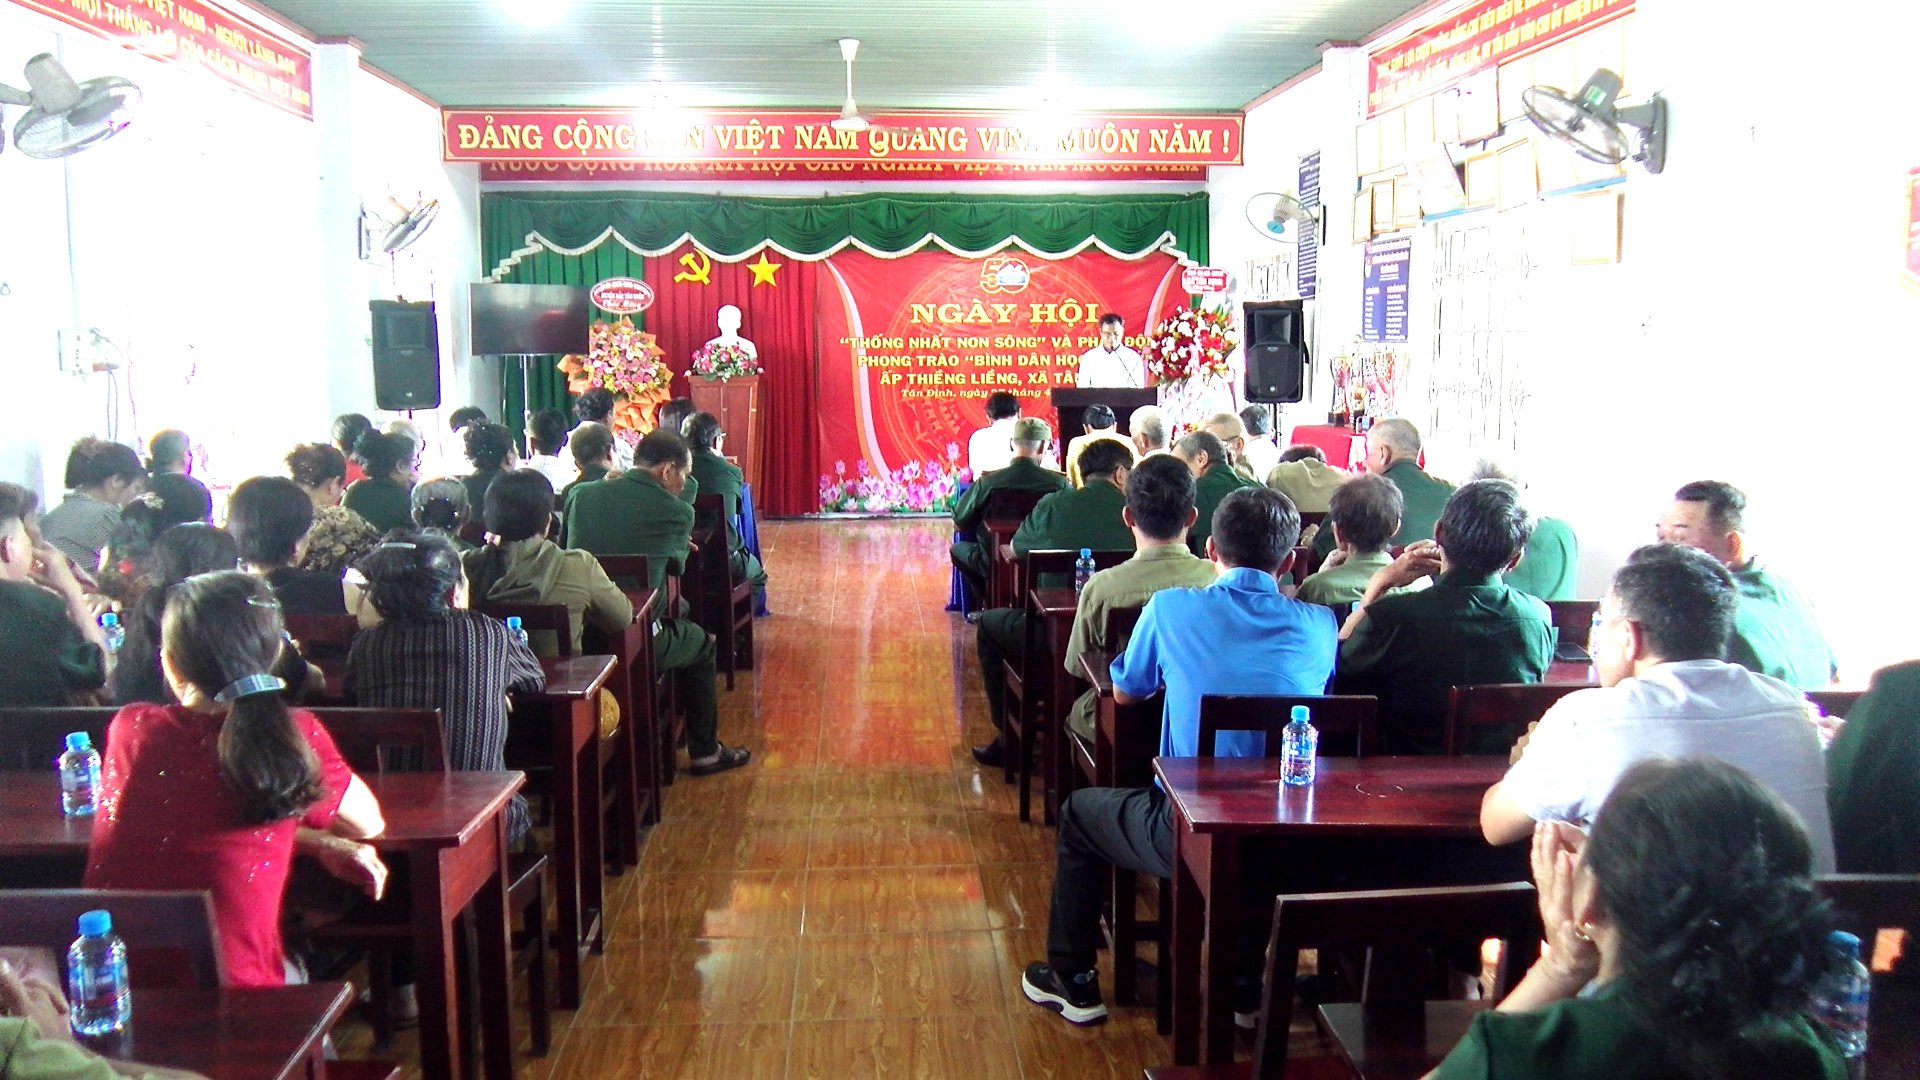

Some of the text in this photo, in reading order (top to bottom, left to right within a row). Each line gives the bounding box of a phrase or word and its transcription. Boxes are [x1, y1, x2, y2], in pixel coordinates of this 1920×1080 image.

[178, 5, 206, 34] NAM
[458, 115, 543, 149] ĐẢNG
[553, 117, 636, 155] CỘNG
[712, 118, 785, 155] VIỆT
[794, 125, 859, 150] NAM
[868, 126, 968, 157] QUANG
[976, 127, 1042, 151] VIN
[1057, 121, 1140, 153] MUÔN
[1149, 122, 1212, 153] NĂM
[1222, 129, 1230, 153] !
[910, 298, 1099, 327] NGÀY HỘI
[840, 333, 1151, 349] “THỐNG NHẤT NON SÔNG” VÀ PH ĐỘN
[857, 355, 912, 367] PHONG
[916, 353, 959, 367] TRÀO
[964, 353, 1012, 366] “BÌNH
[1018, 353, 1050, 366] DÂN
[880, 370, 902, 384] ẤP
[907, 369, 966, 384] THIỀNG
[970, 369, 1022, 386] LIỀNG,
[1027, 370, 1048, 384] XÃ
[901, 388, 923, 397] Tân
[959, 388, 988, 399] ngày
